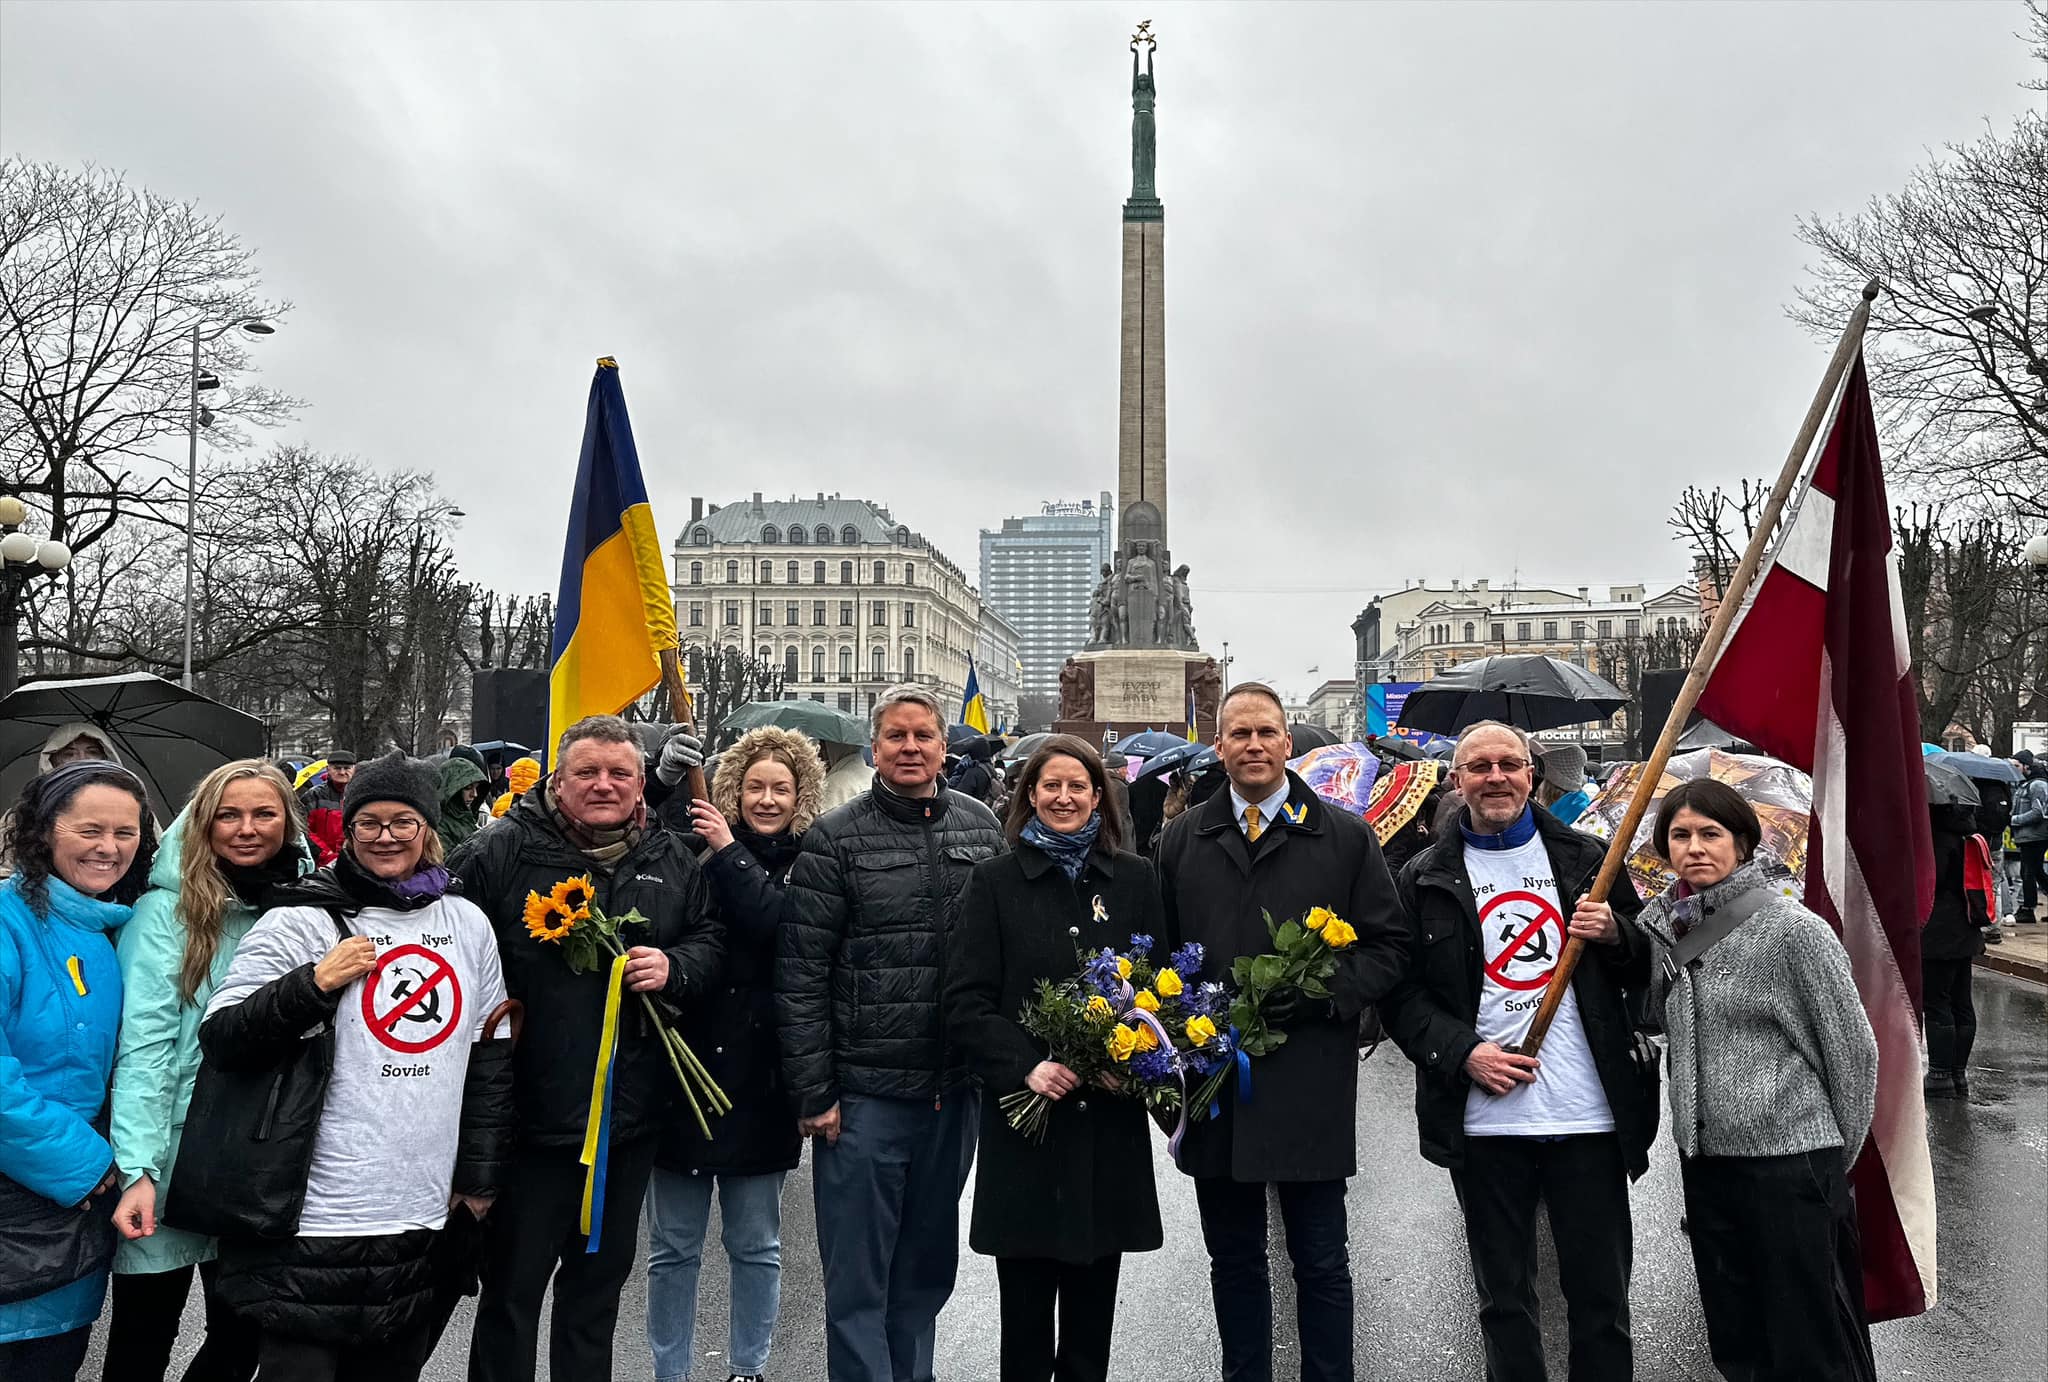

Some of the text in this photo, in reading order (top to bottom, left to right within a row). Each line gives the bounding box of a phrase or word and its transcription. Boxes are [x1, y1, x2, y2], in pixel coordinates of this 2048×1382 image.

[1539, 731, 1577, 740] ROCKET
[1472, 877, 1557, 897] yet Nyet
[421, 933, 453, 948] Nyet
[1504, 997, 1544, 1012] Sovie
[381, 1064, 431, 1078] Soviet
